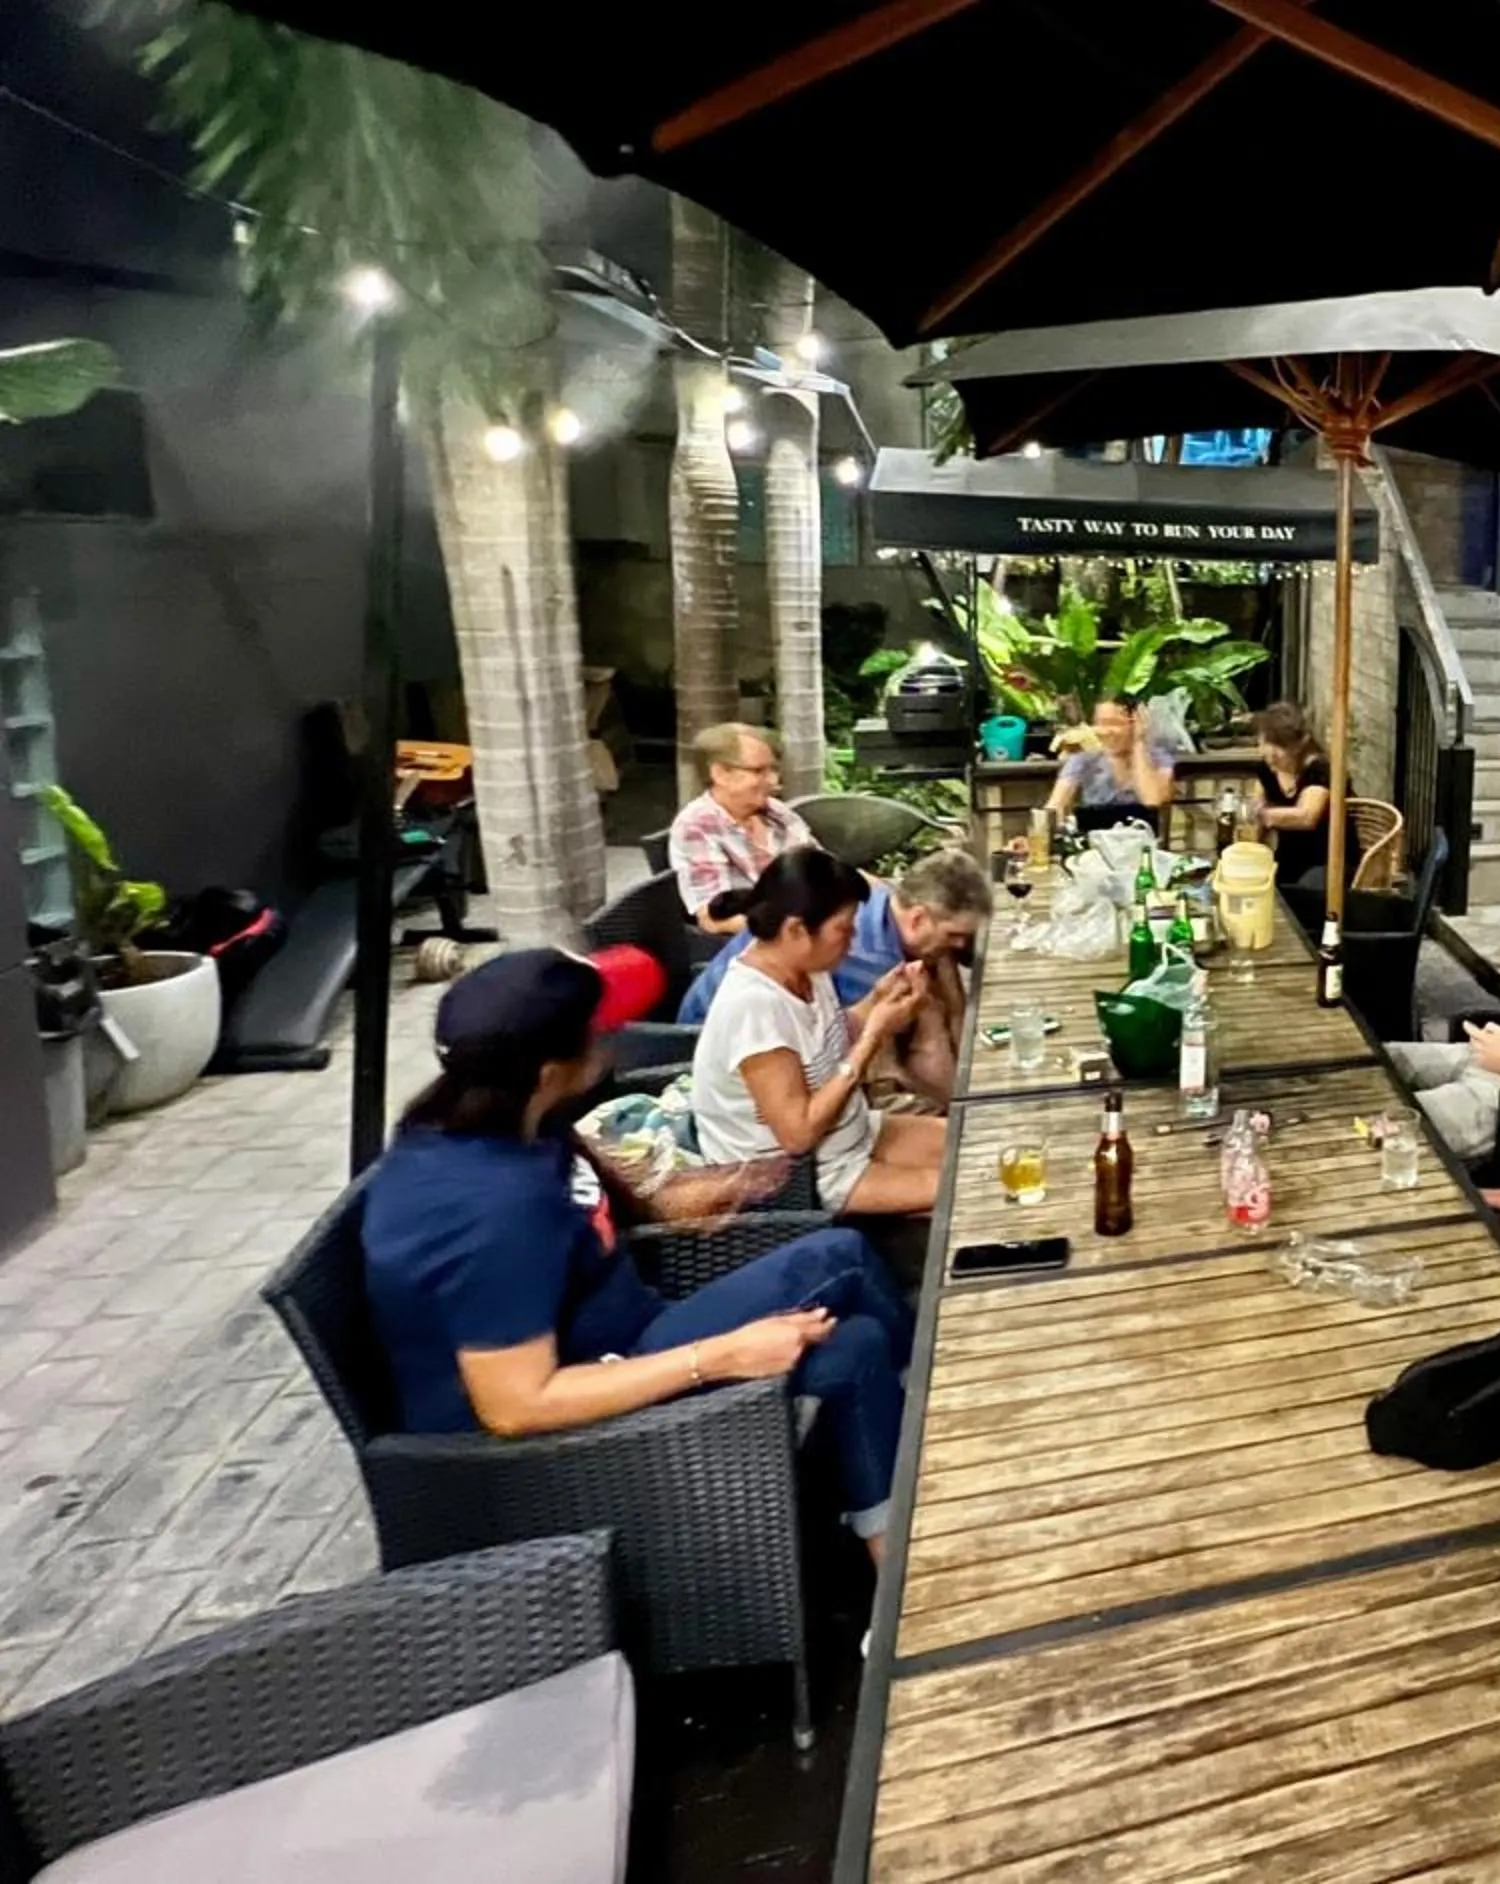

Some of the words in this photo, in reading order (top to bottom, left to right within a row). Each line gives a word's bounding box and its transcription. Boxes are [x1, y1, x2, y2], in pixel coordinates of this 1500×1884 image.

[1017, 517, 1076, 533] TASTY
[1083, 520, 1125, 535] WAY
[1131, 522, 1159, 537] TO
[1163, 524, 1199, 538] RUN
[1207, 525, 1256, 539] YOUR
[1261, 526, 1296, 540] DAY
